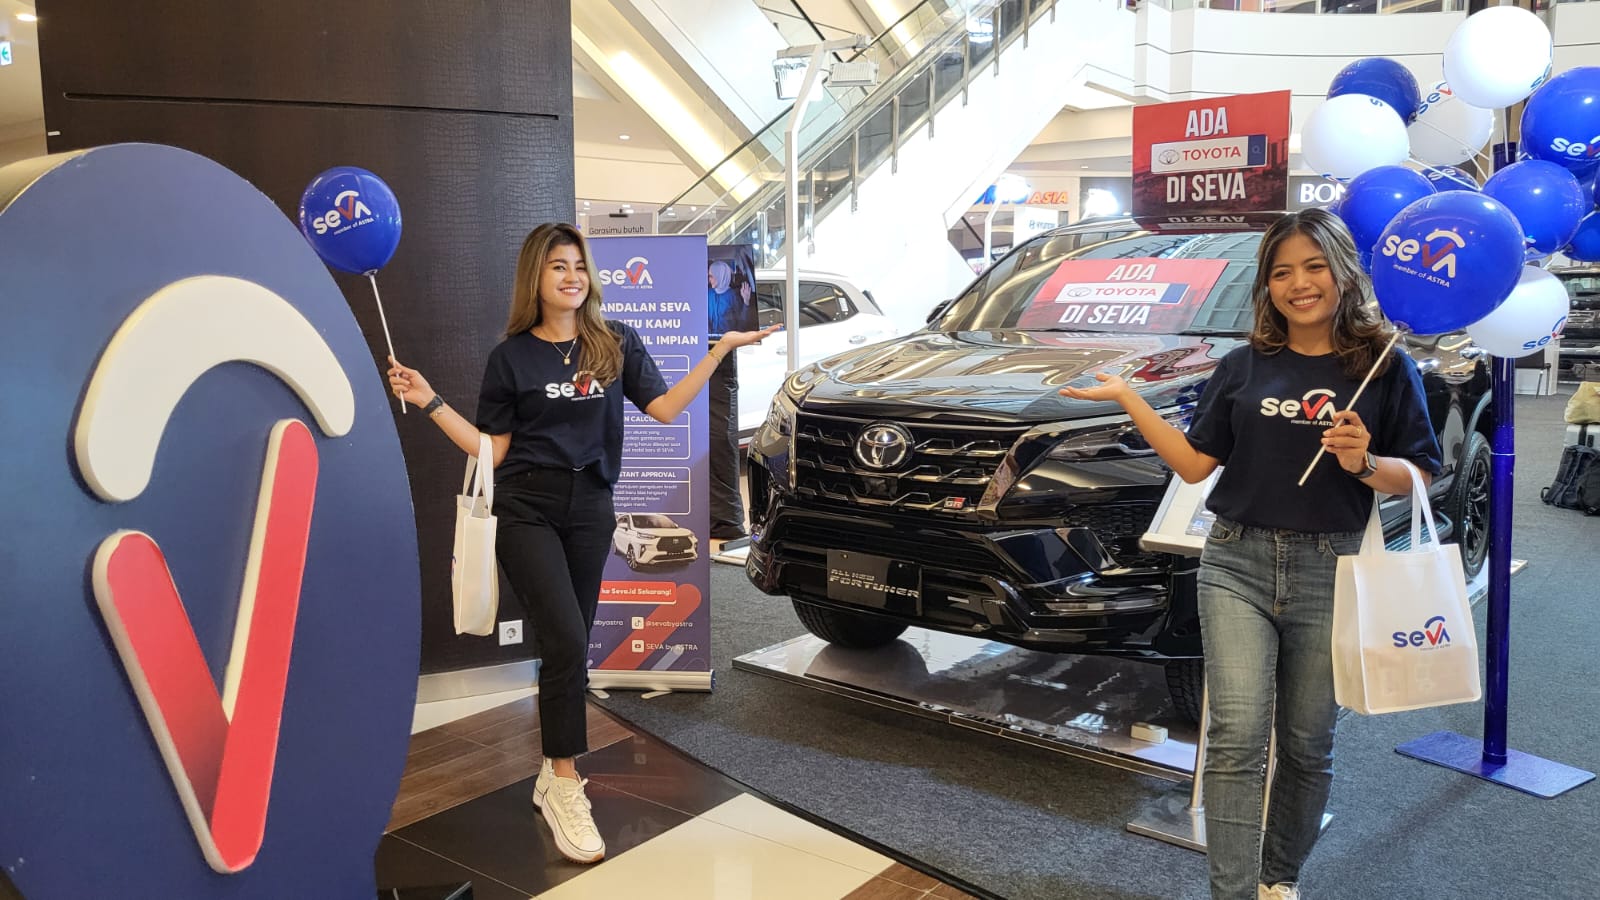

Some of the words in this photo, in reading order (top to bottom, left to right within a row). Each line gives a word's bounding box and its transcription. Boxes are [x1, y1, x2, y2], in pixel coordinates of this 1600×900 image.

[1185, 107, 1228, 137] ADA
[1182, 146, 1241, 160] TOYOTA
[1166, 176, 1186, 203] DI
[1191, 172, 1246, 202] SEVA
[1026, 191, 1068, 204] ASIA
[1106, 264, 1157, 280] ADA
[1393, 264, 1418, 275] member
[1427, 276, 1450, 288] ASTRA
[1094, 288, 1157, 296] TOYOTA
[660, 302, 691, 312] SEVA
[1058, 305, 1088, 323] DI
[1087, 305, 1151, 324] SEVA
[646, 319, 681, 328] KAMU
[657, 336, 698, 345] IMPIAN
[831, 569, 850, 577] ALL
[829, 575, 920, 599] FORTUNER
[665, 643, 674, 651] by
